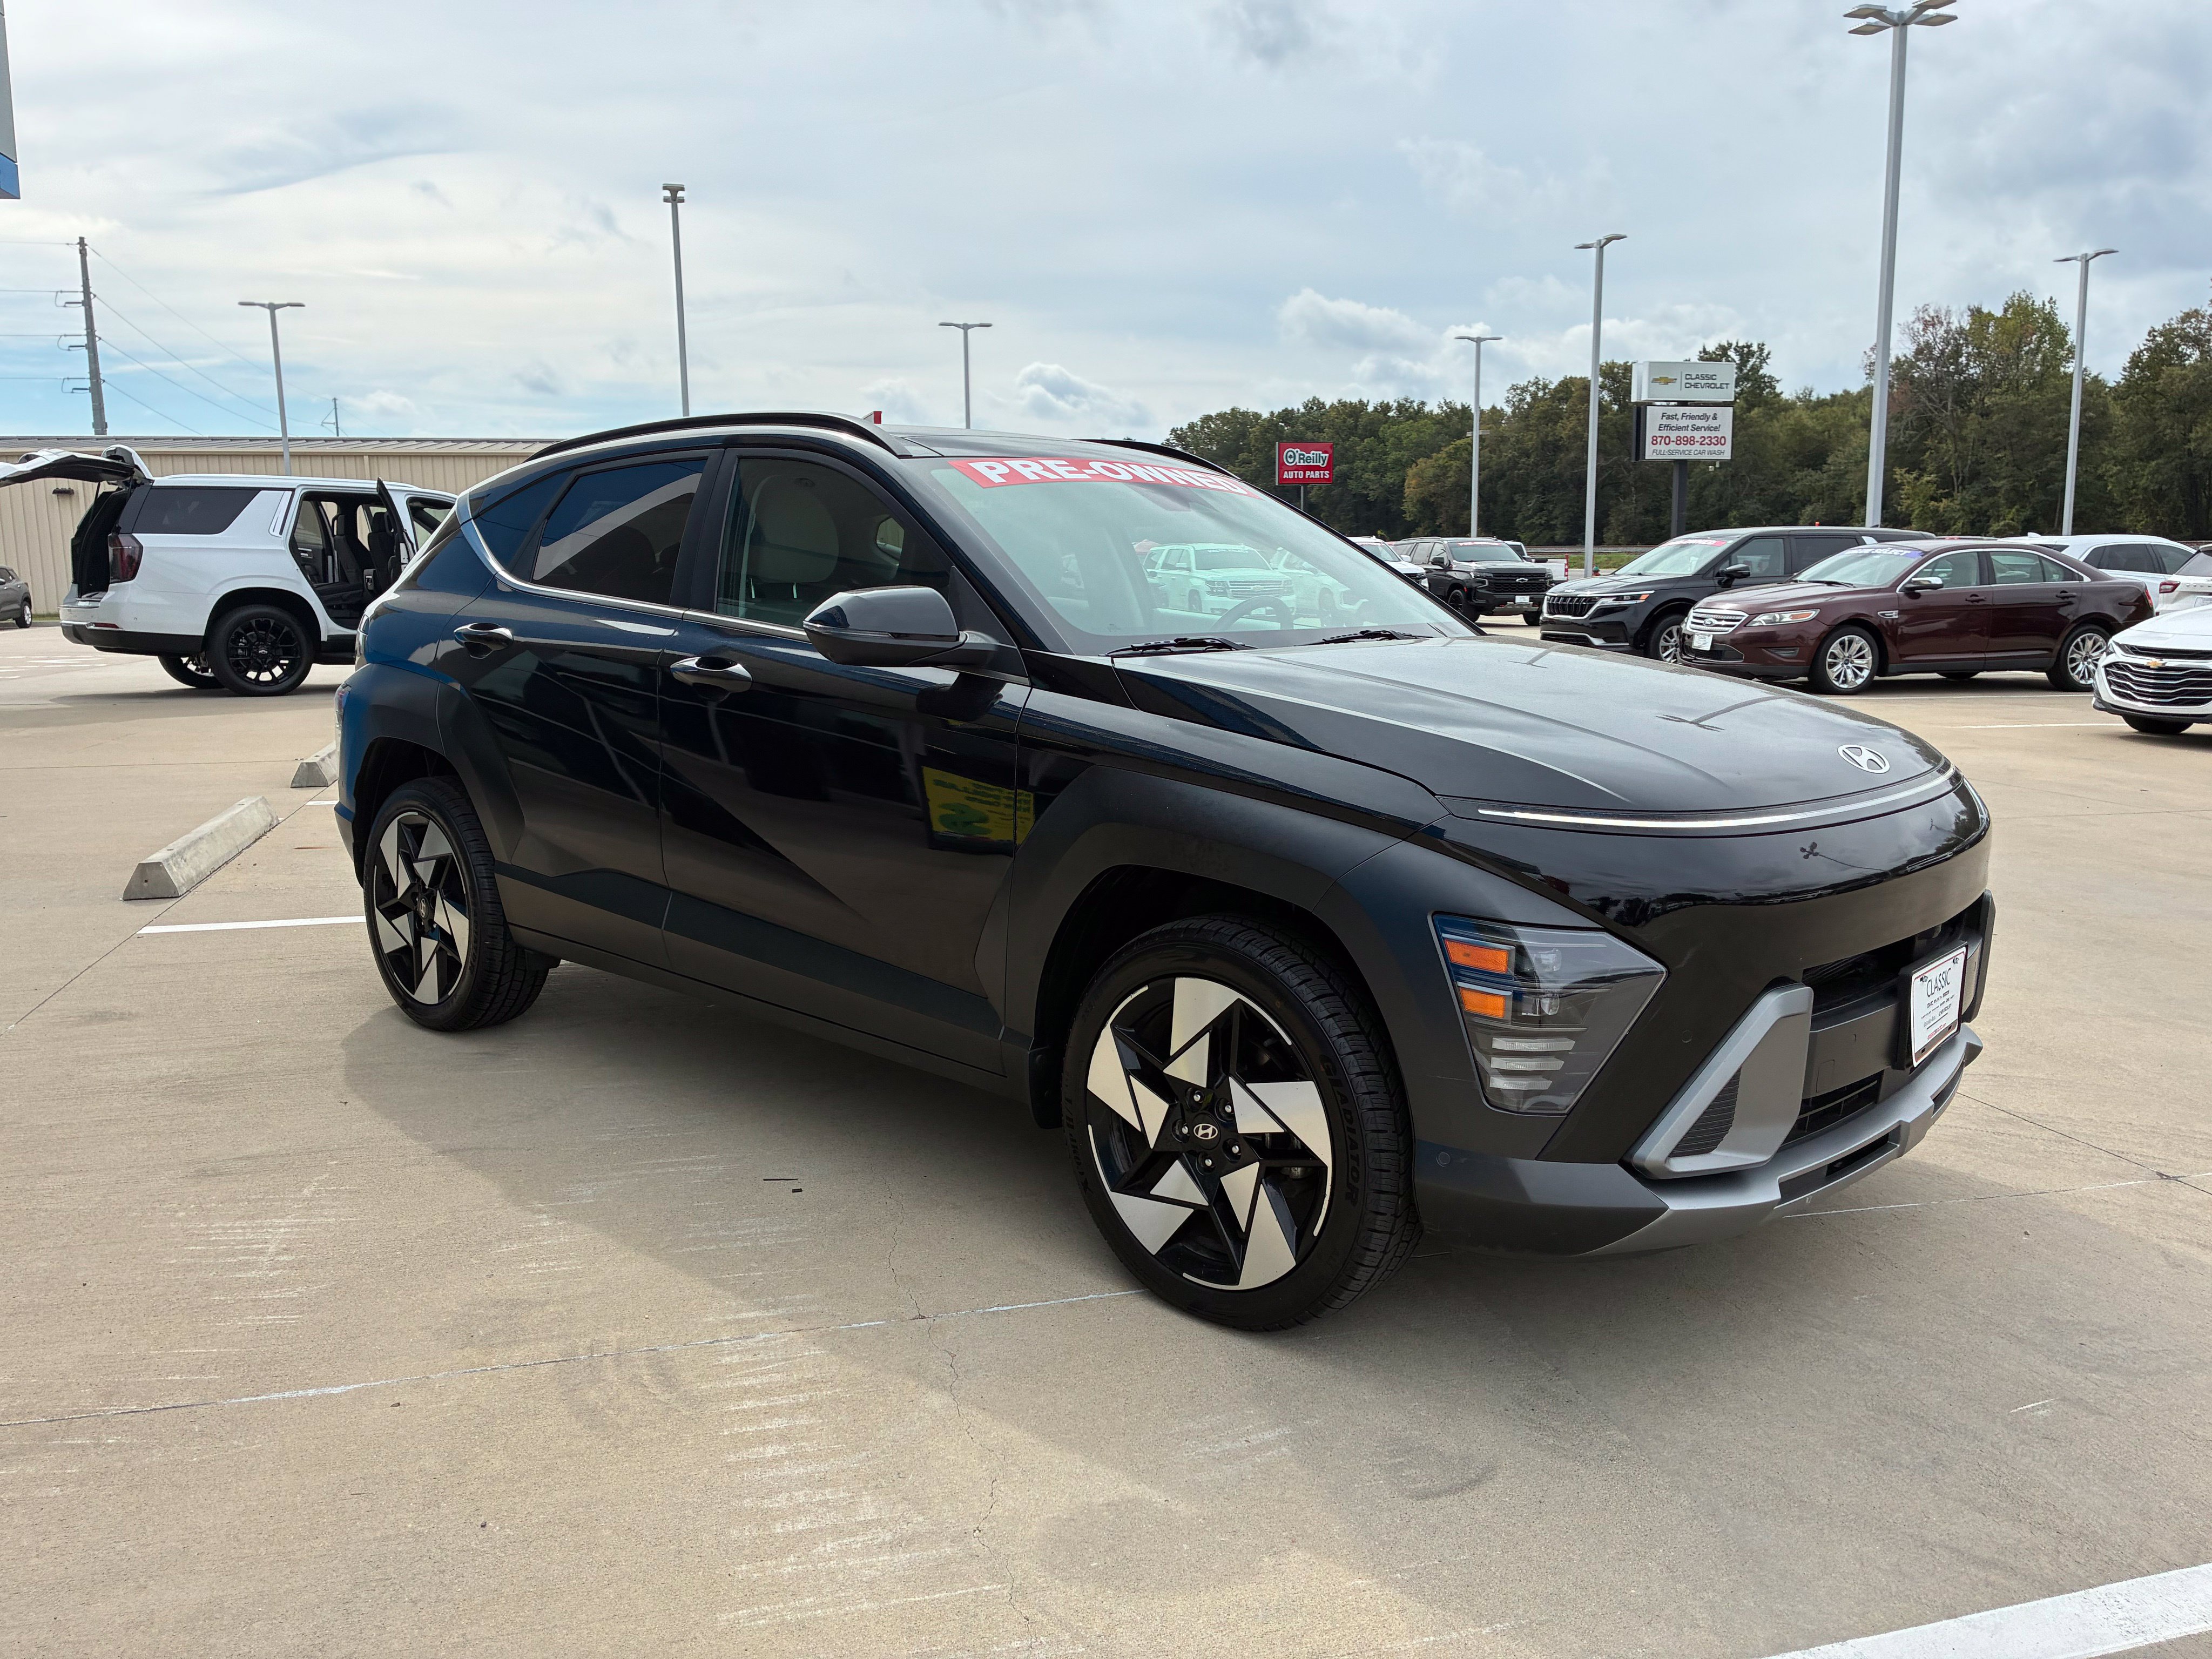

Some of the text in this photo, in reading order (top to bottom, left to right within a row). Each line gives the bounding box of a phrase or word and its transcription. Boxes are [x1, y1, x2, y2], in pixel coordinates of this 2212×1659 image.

[1661, 413, 1679, 421] Fast,
[1681, 413, 1710, 422] Friendly
[1651, 435, 1726, 446] 870-898-2330
[1285, 449, 1327, 466] O'Reilly
[968, 460, 1249, 495] PRE-OWNED
[1926, 968, 1951, 998] CLASSIC
